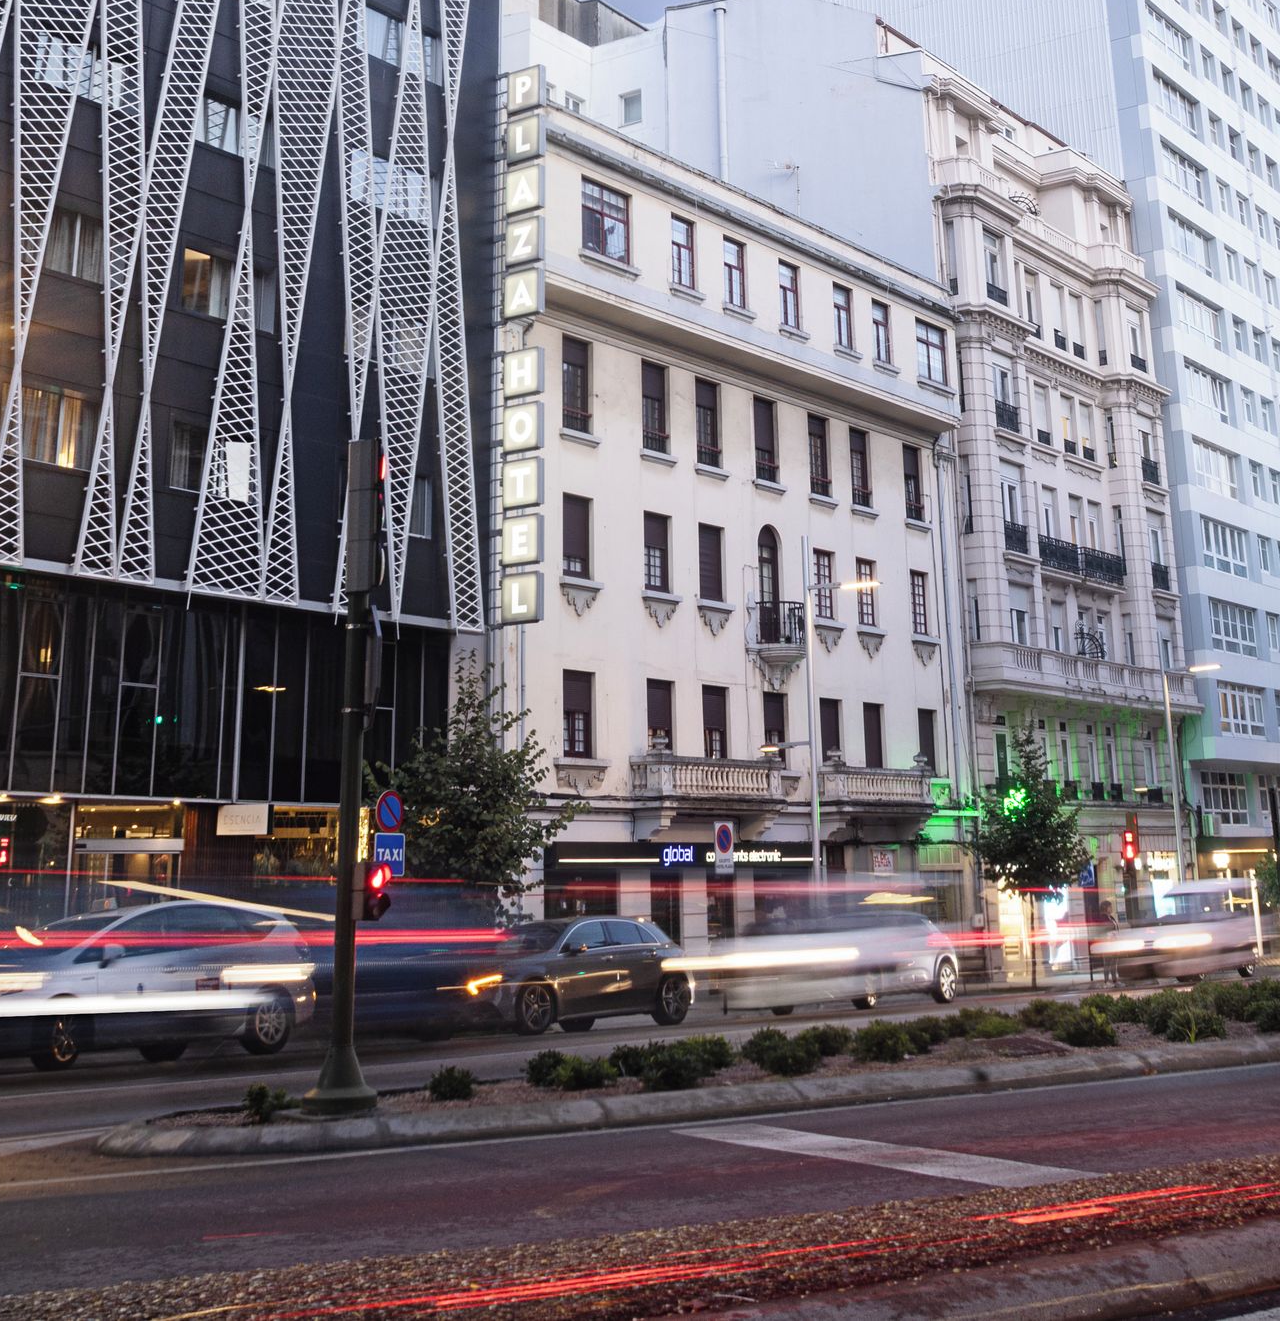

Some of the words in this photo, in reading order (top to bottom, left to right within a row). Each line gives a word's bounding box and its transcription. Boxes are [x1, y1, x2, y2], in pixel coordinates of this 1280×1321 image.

[510, 76, 534, 310] PLAZA
[508, 356, 533, 614] HOTEL
[377, 848, 403, 862] TAXI
[663, 845, 693, 866] global
[706, 850, 748, 862] coents
[749, 849, 781, 862] electronic
